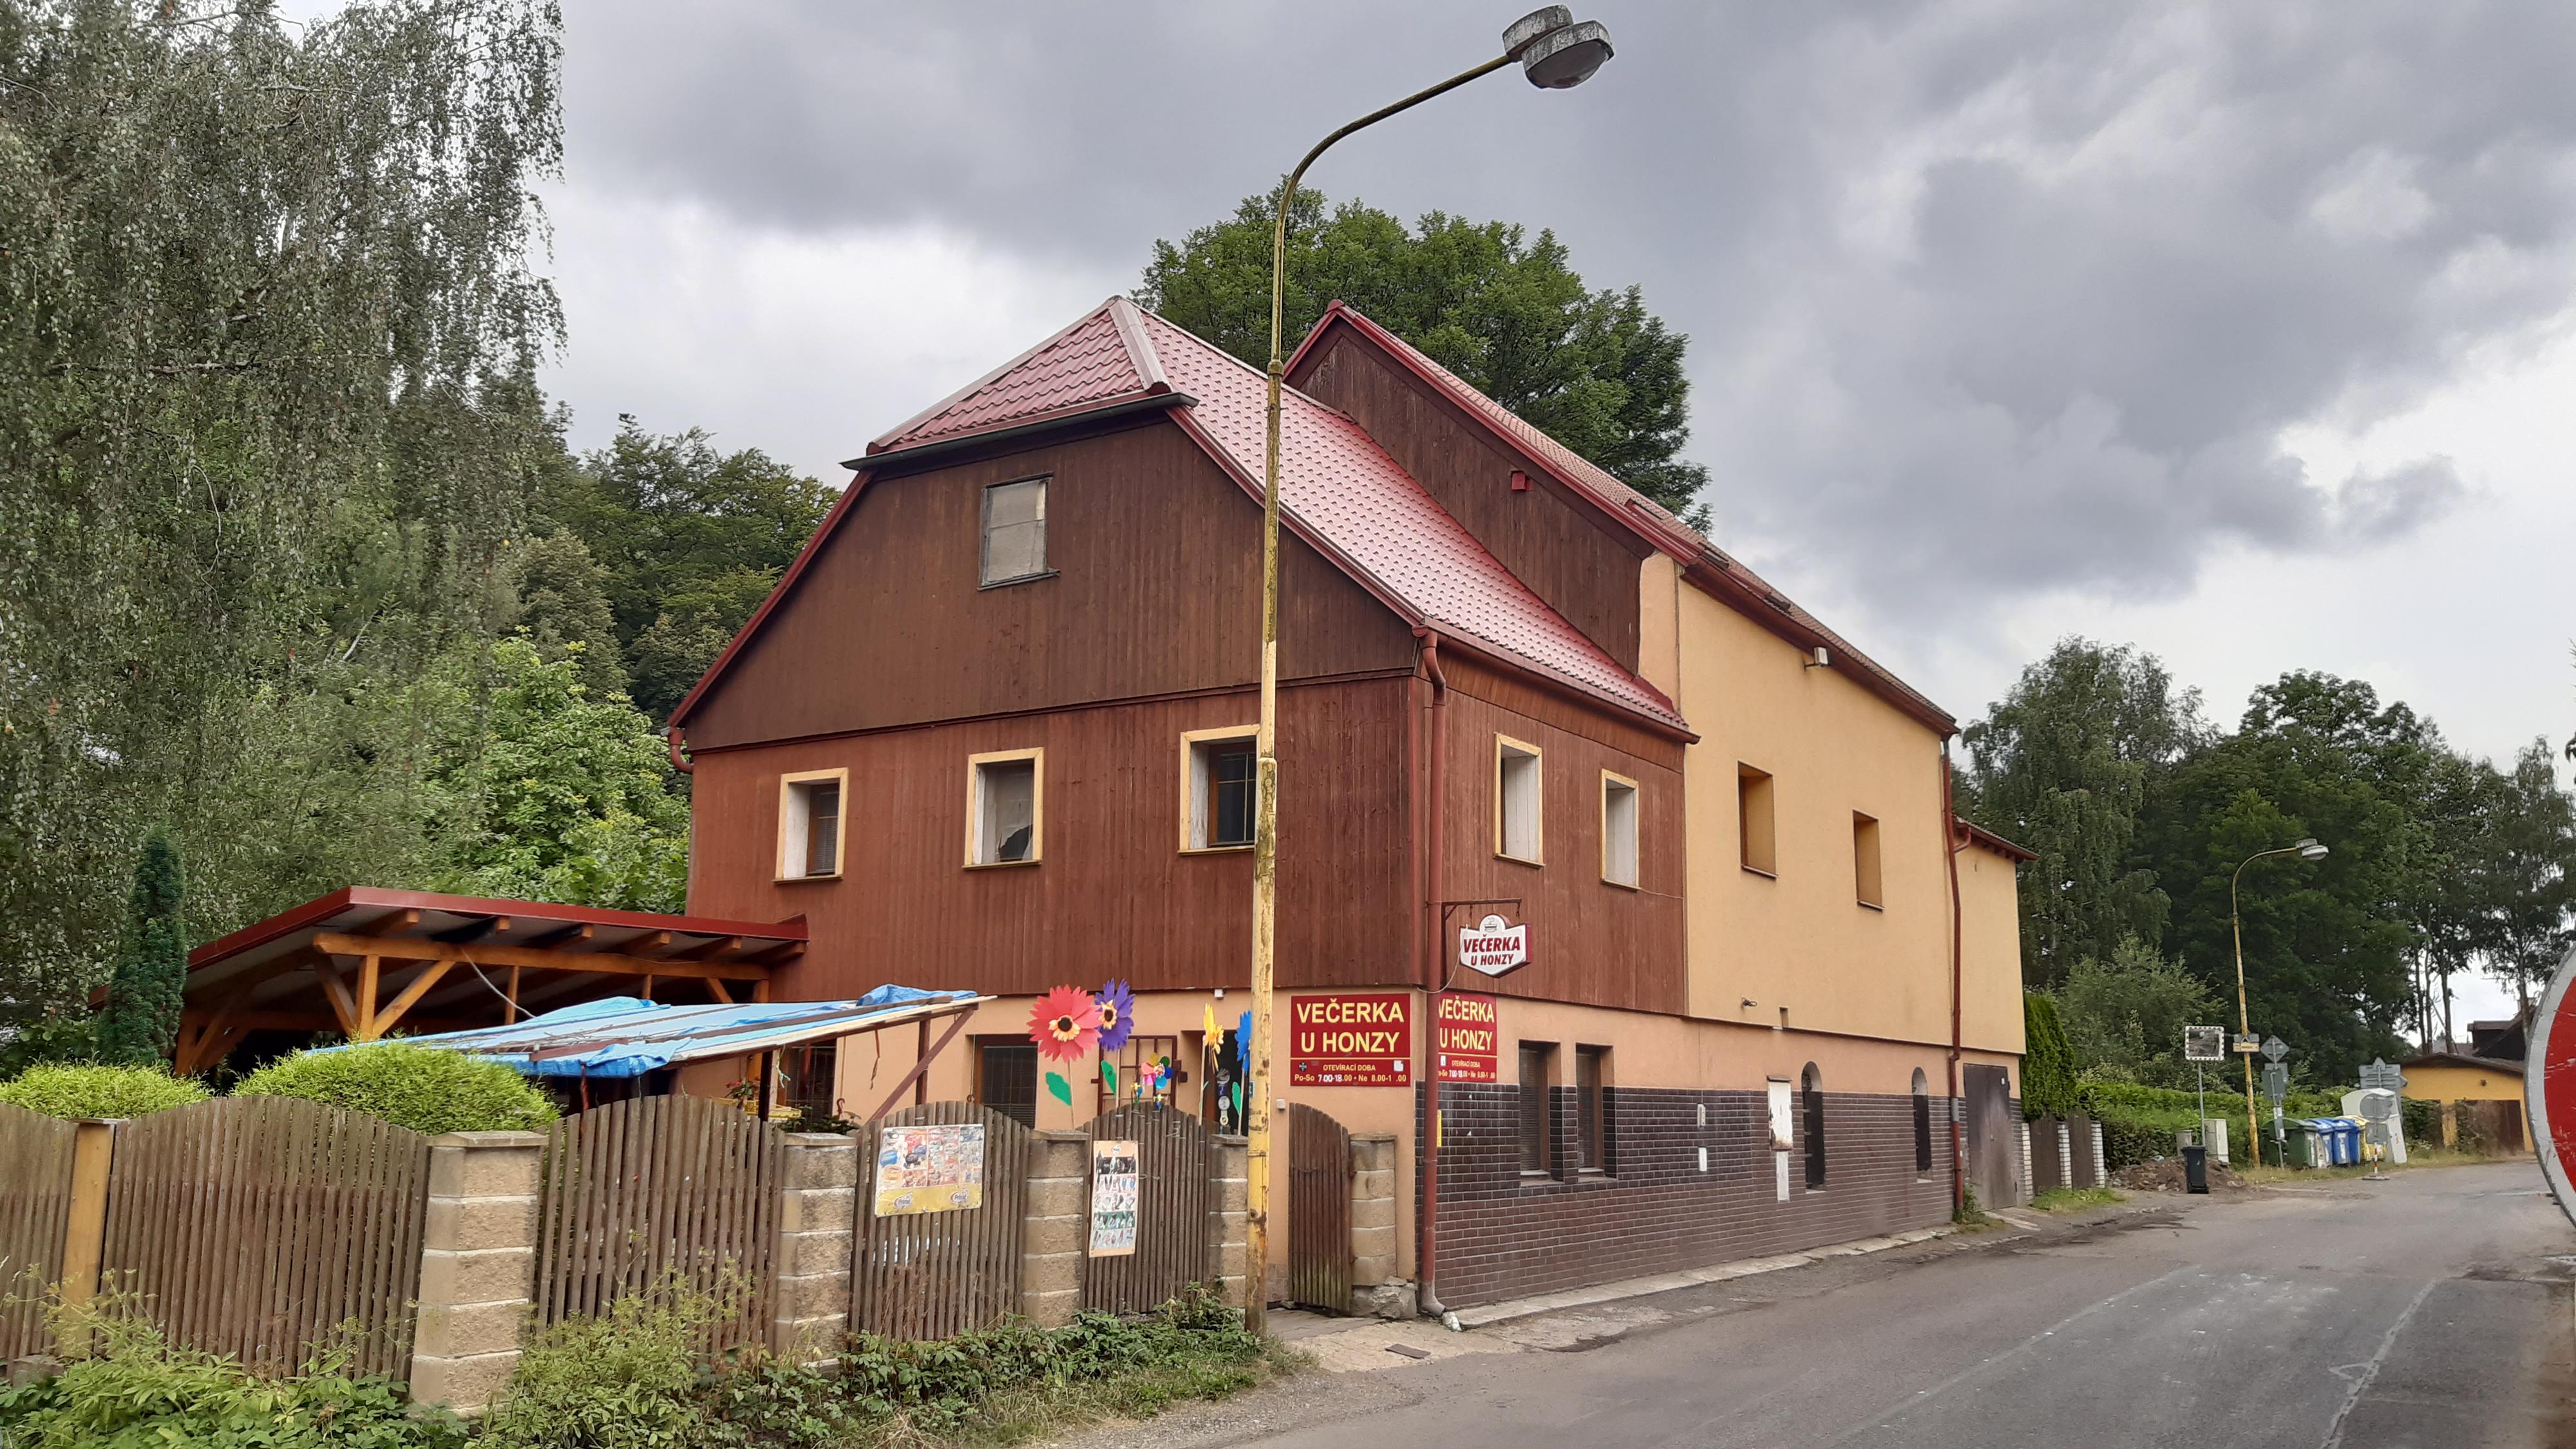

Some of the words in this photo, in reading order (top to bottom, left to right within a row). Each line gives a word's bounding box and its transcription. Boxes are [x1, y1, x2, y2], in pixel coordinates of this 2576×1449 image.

[1464, 933, 1520, 953] VEČERKA
[1470, 955, 1477, 965] U
[1481, 954, 1514, 965] HONZY
[1296, 998, 1405, 1023] VEČERKA
[1439, 995, 1495, 1023] VEČERKA
[1301, 1032, 1315, 1052] U
[1323, 1032, 1400, 1052] HONZY
[1439, 1027, 1448, 1048] U
[1452, 1028, 1493, 1051] HONZY
